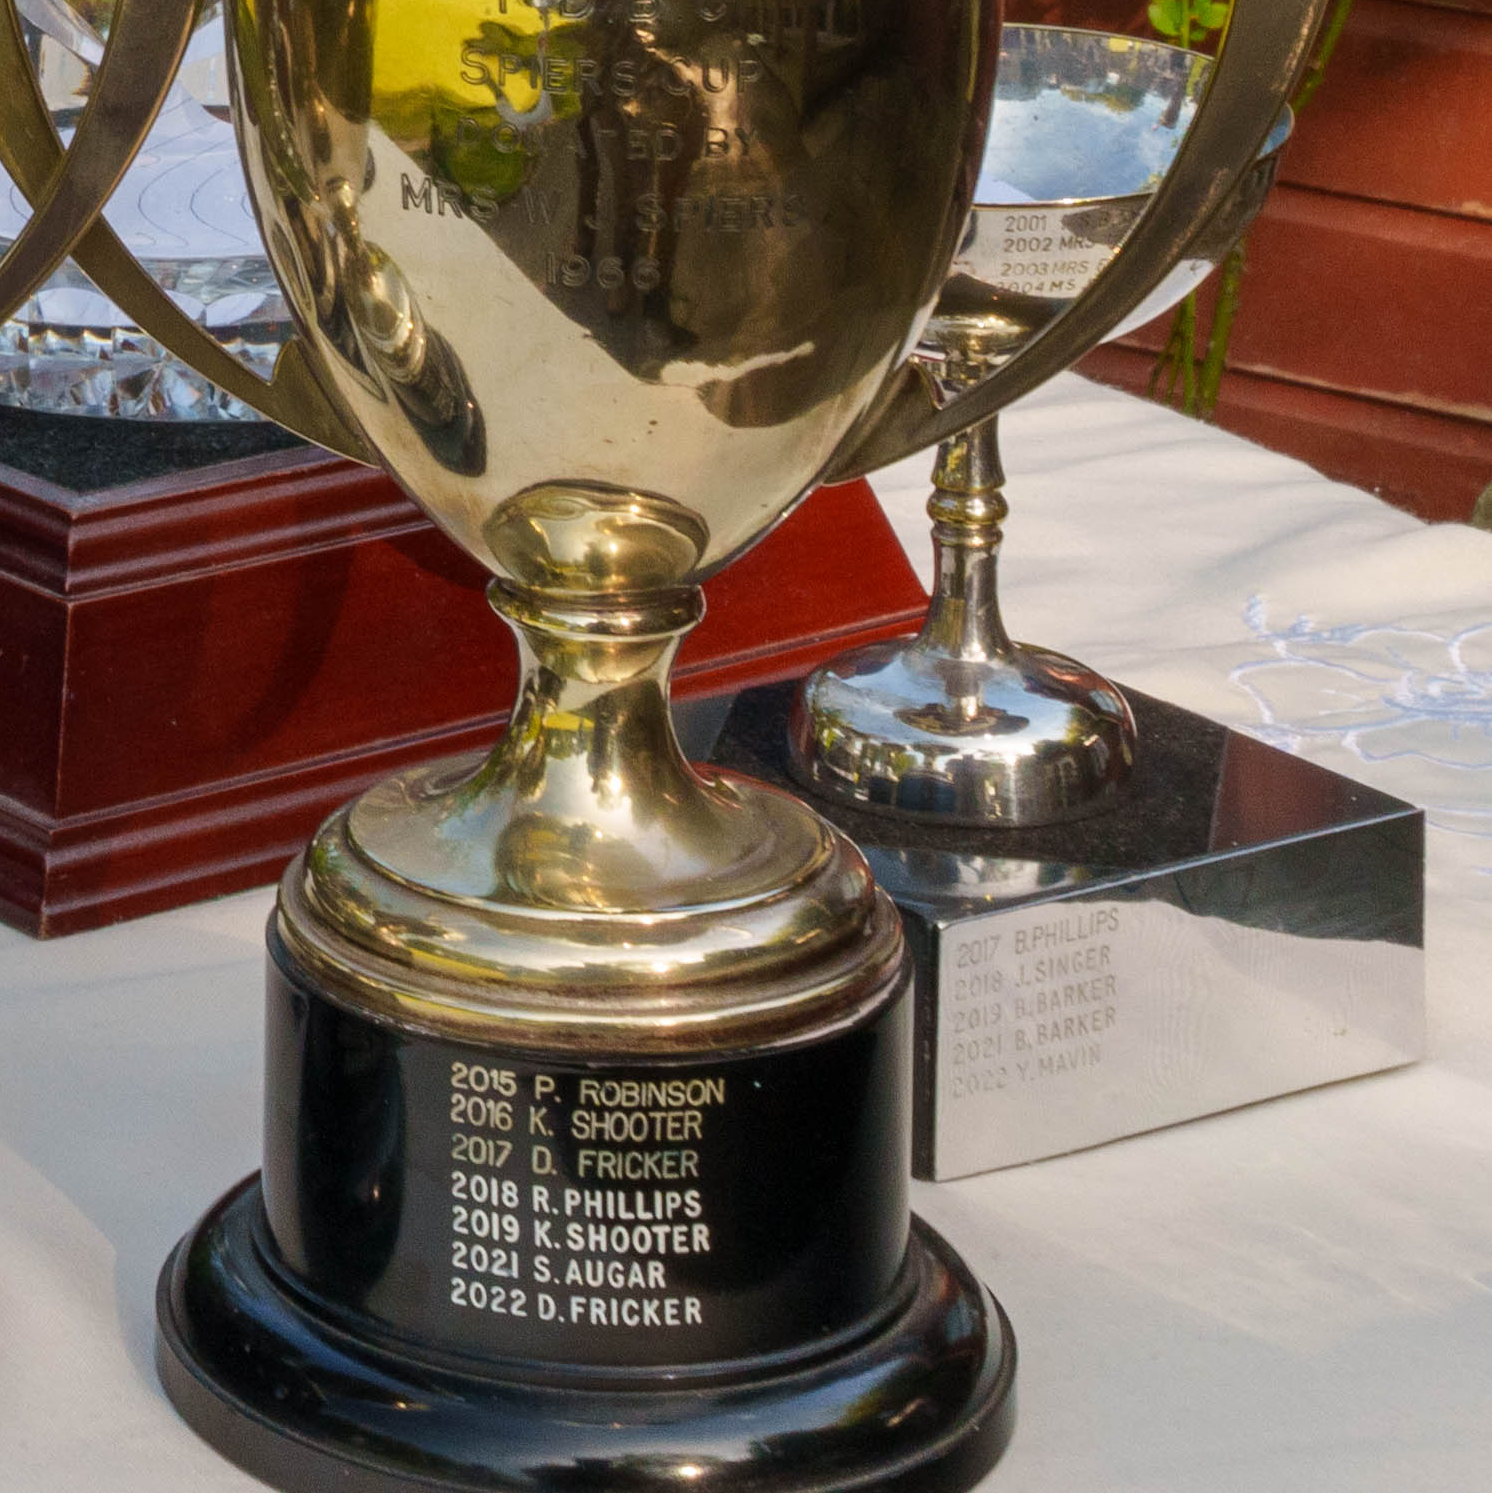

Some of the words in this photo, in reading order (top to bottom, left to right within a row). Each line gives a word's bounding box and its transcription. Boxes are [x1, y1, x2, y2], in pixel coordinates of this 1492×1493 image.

[460, 46, 641, 98] SPIERS
[663, 54, 766, 98] CUP
[704, 125, 759, 159] BY
[400, 170, 500, 225] MRS
[1004, 214, 1047, 233] 2001
[1003, 236, 1054, 254] 2002
[544, 251, 663, 292] 1966
[1000, 261, 1050, 277] 2003
[1052, 260, 1089, 276] MRS
[956, 934, 1001, 970] 2017
[954, 969, 1004, 1003] 2018
[953, 1003, 1003, 1035] 2019
[953, 1034, 1003, 1066] 2021
[450, 1061, 518, 1098] 2015
[579, 1077, 726, 1108] ROBINSON
[952, 1066, 1008, 1100] 2022
[450, 1093, 514, 1132] 2016
[570, 1109, 704, 1143] SHOOTER
[451, 1132, 514, 1169] 2017
[577, 1148, 700, 1181] FRICKER
[450, 1170, 520, 1209] 2018
[451, 1205, 520, 1244] 2019
[451, 1240, 519, 1279] 2021
[450, 1276, 528, 1318] 2022
